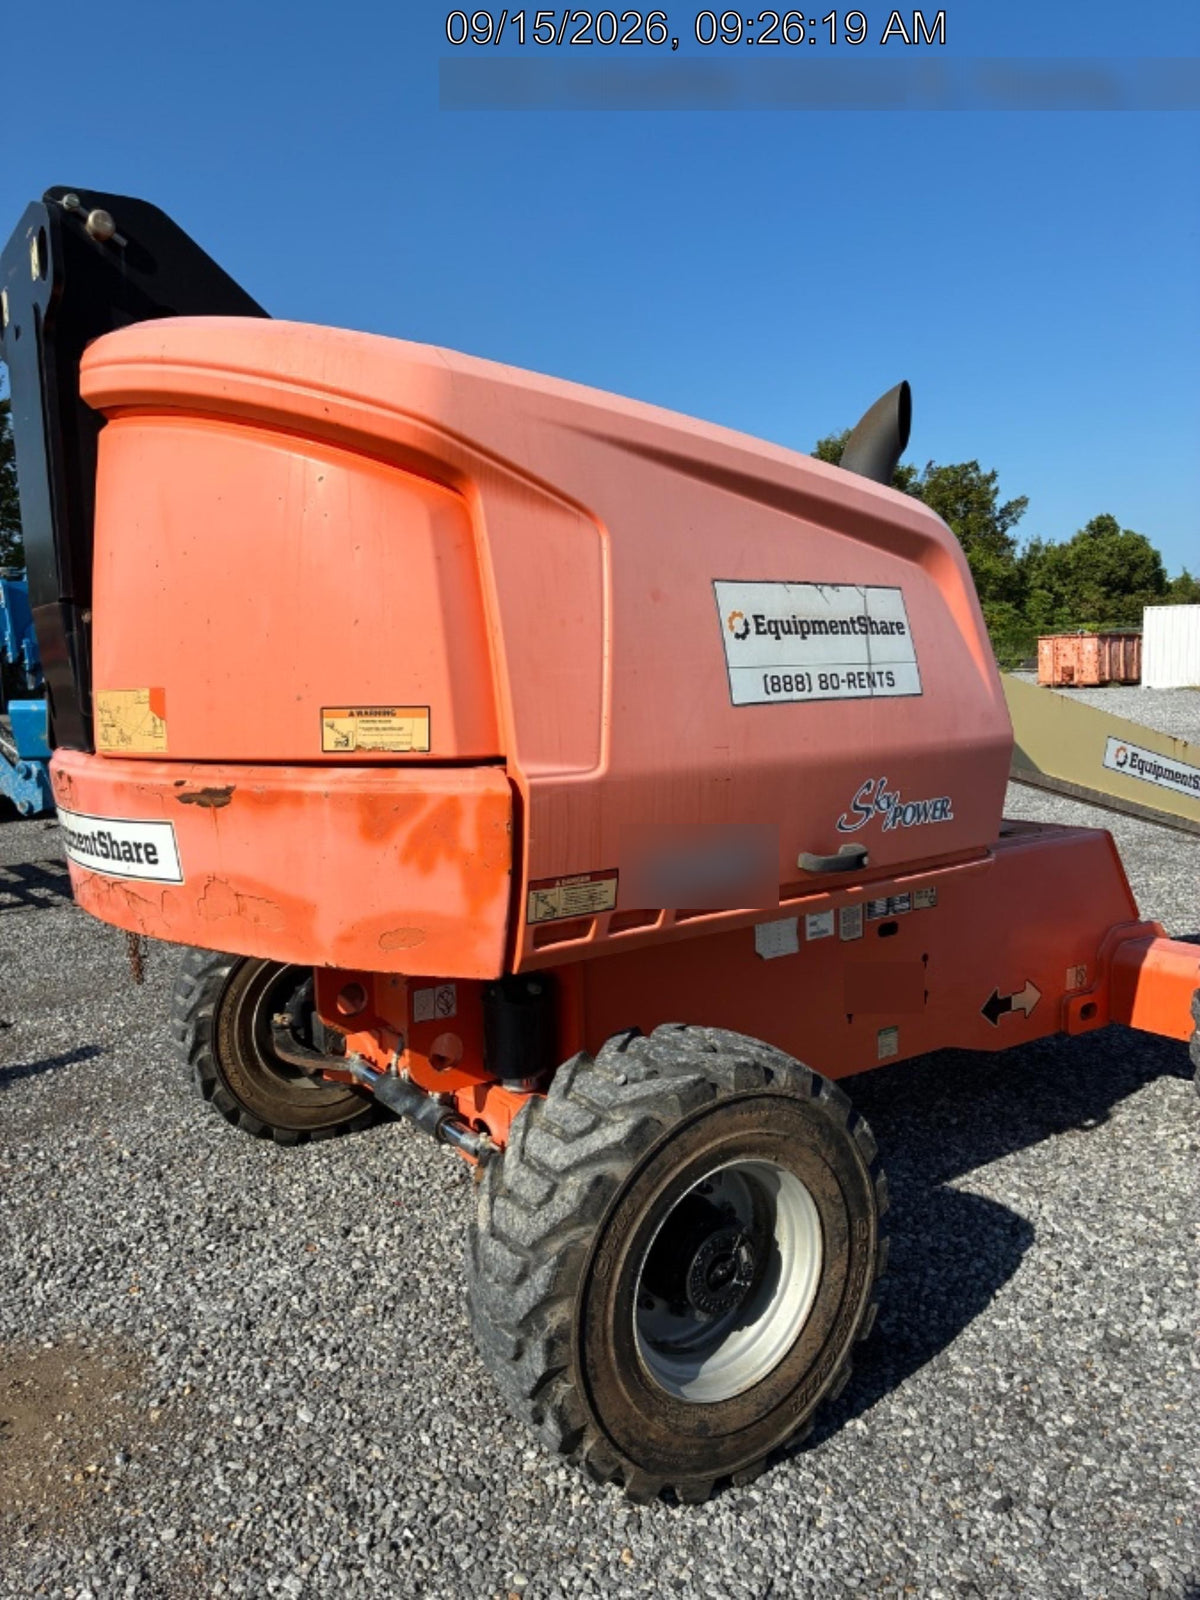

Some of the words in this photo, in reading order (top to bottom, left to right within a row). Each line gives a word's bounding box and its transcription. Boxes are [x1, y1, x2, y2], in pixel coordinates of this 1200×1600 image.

[752, 614, 905, 640] EquipmentShare
[763, 672, 812, 695] (888)
[818, 671, 896, 691] 80-RENTS
